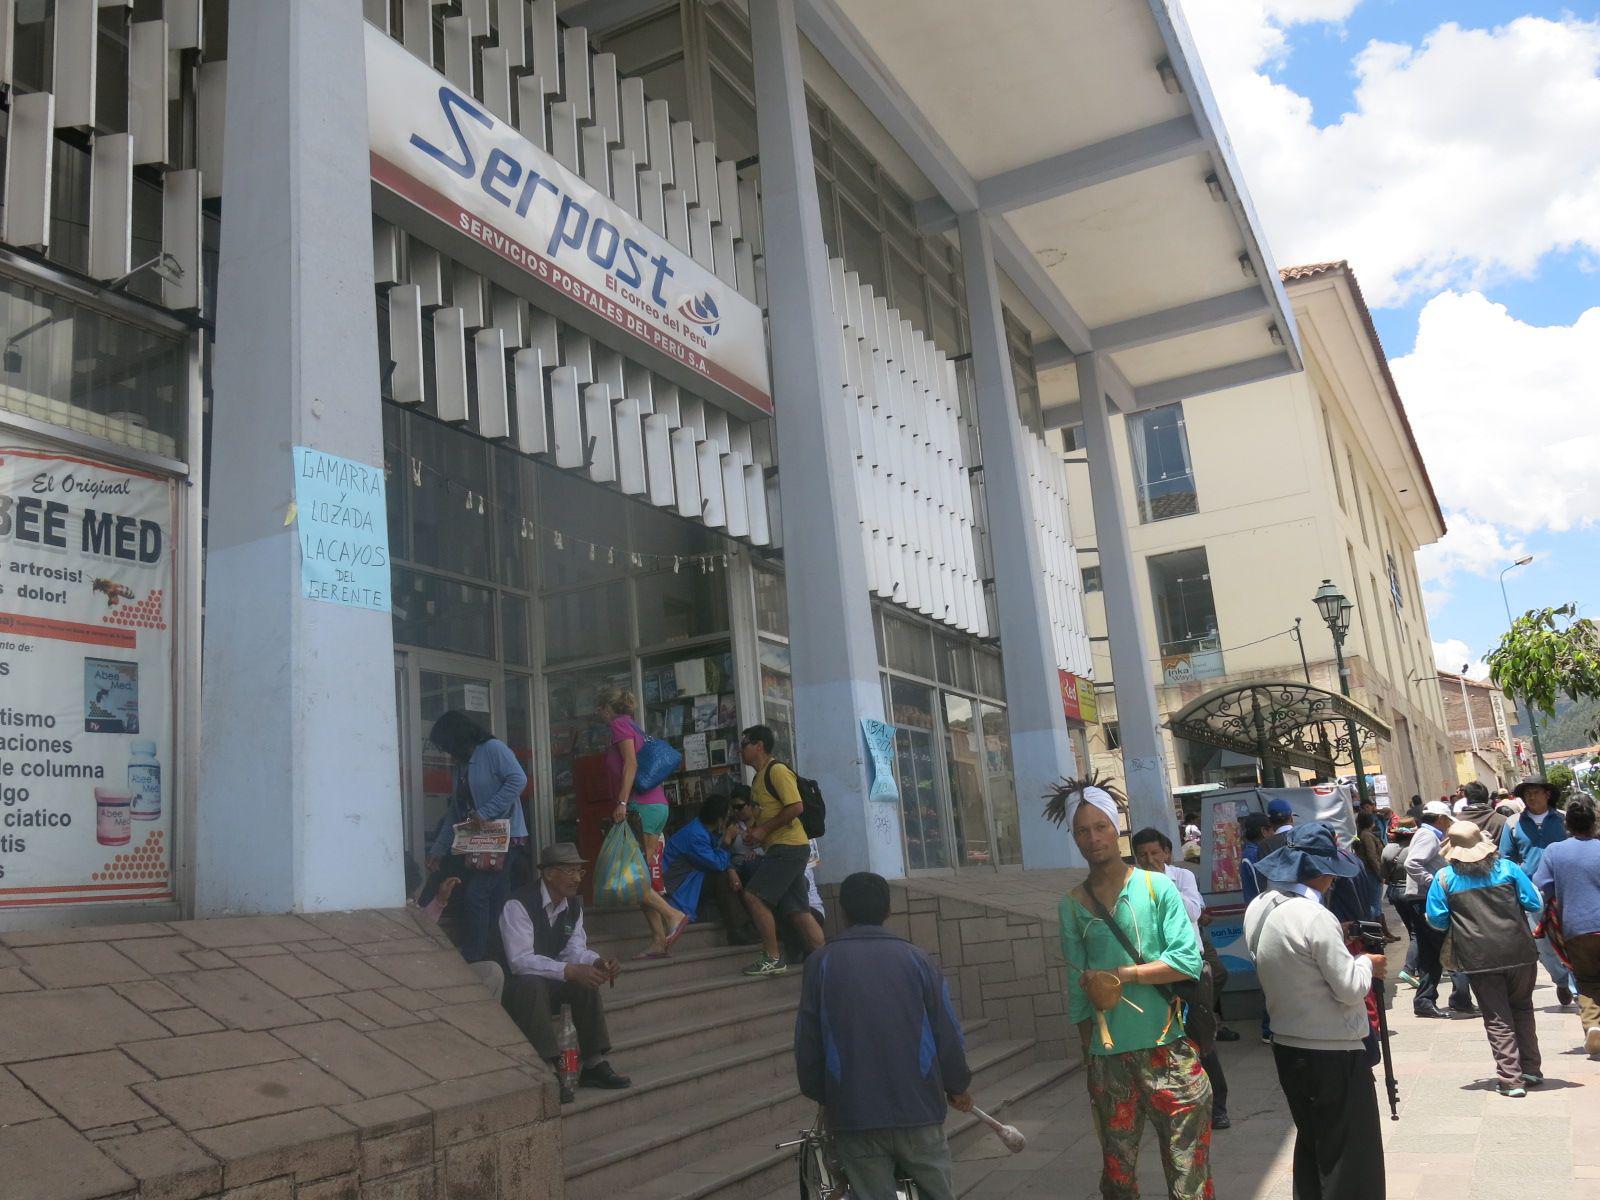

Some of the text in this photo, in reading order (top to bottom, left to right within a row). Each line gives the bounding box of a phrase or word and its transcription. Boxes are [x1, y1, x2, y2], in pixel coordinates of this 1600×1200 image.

[409, 86, 675, 309] Serpost
[459, 212, 710, 374] SERVICIOS POSTALES DEL PERÚ S.A.
[605, 273, 707, 349] El correo del Perú
[32, 472, 130, 499] El Original
[302, 450, 381, 497] GAMARRA
[311, 499, 374, 534] LOZADA
[82, 508, 162, 564] MED
[306, 534, 386, 567] LACAYOS
[10, 561, 82, 583] artrosis!
[335, 568, 356, 583] DEL
[17, 584, 67, 604] dolor!
[308, 580, 383, 607] GERENTE
[18, 642, 34, 652] de:
[94, 669, 120, 681] Abee
[1168, 668, 1189, 677] Inka
[21, 759, 104, 778] columna
[4, 808, 71, 827] ciatico
[1, 833, 26, 852] tis
